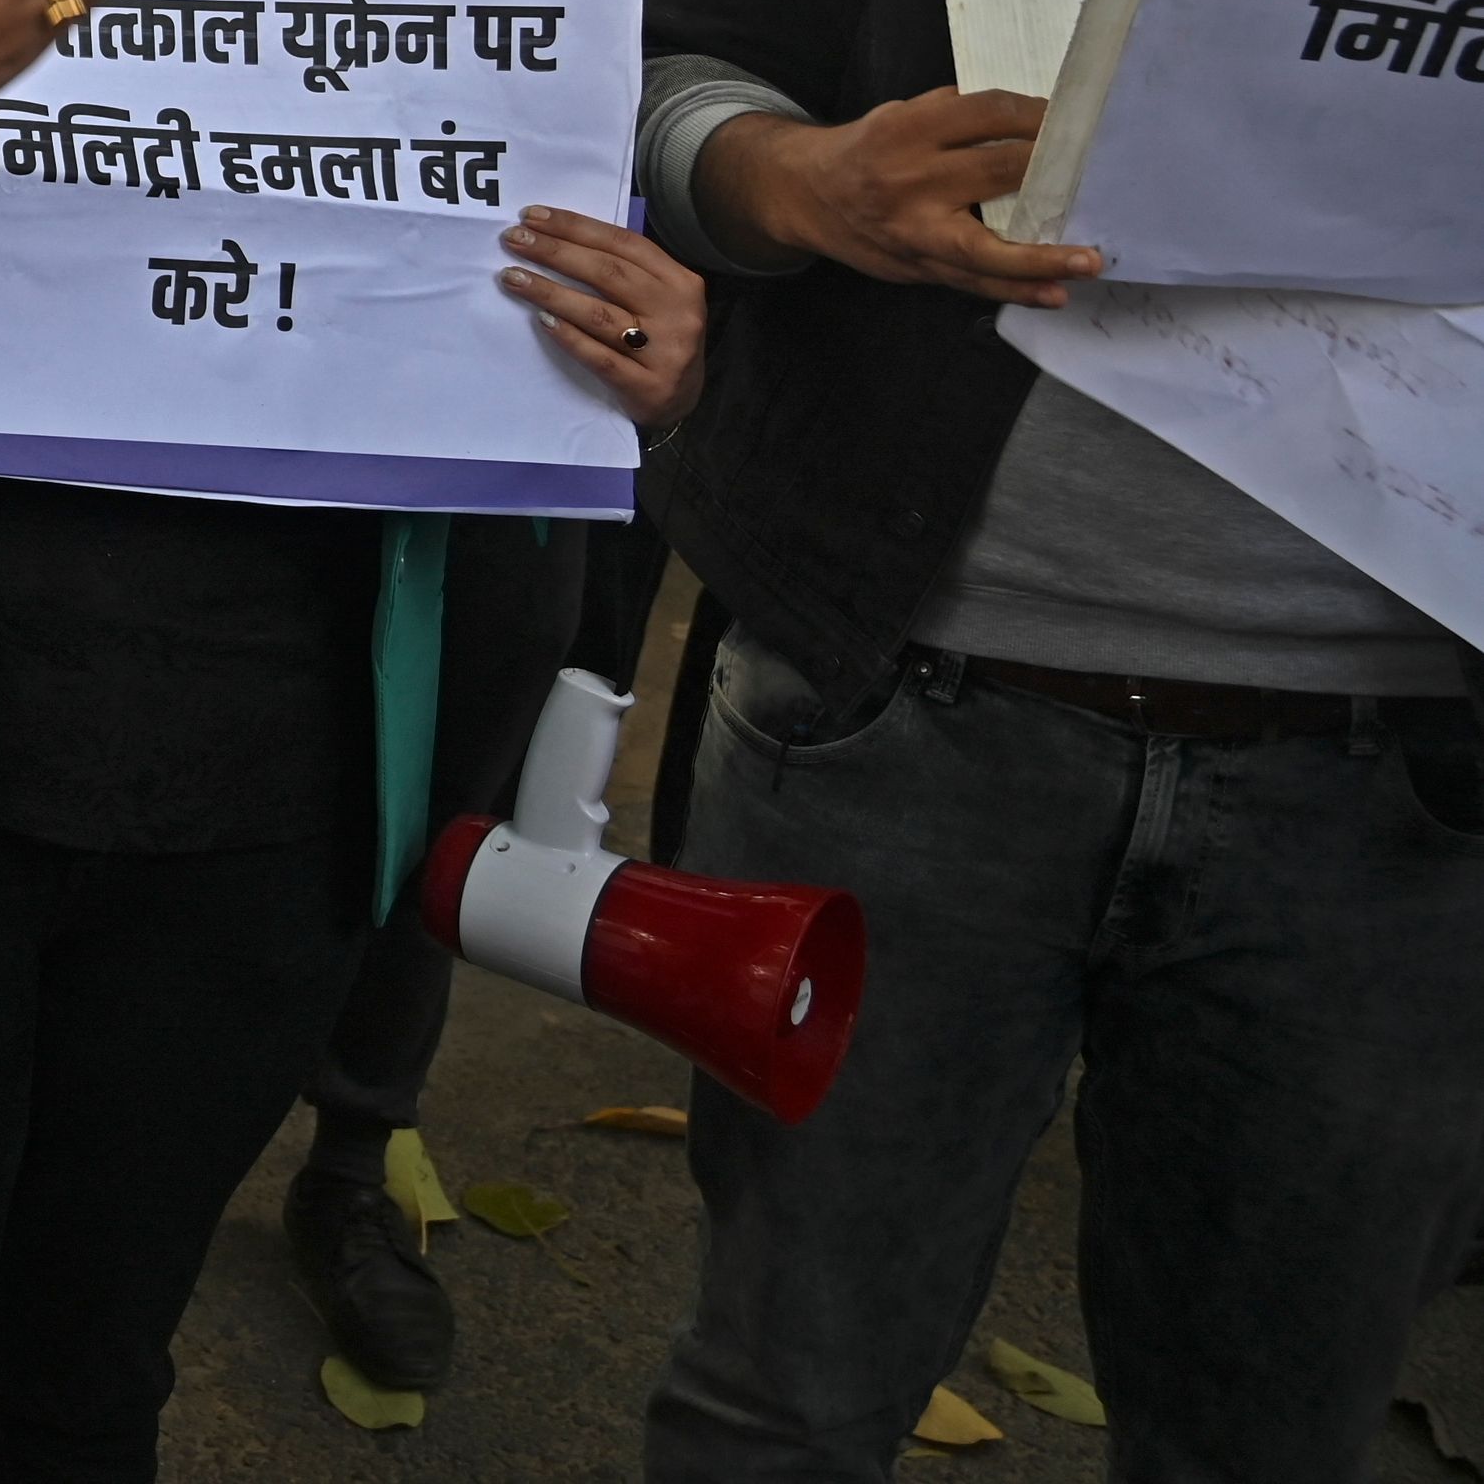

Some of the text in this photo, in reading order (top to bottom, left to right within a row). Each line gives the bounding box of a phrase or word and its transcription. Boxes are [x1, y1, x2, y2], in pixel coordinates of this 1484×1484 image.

[465, 5, 566, 73] पर
[209, 131, 402, 202] हमला
[410, 119, 507, 207] बंद
